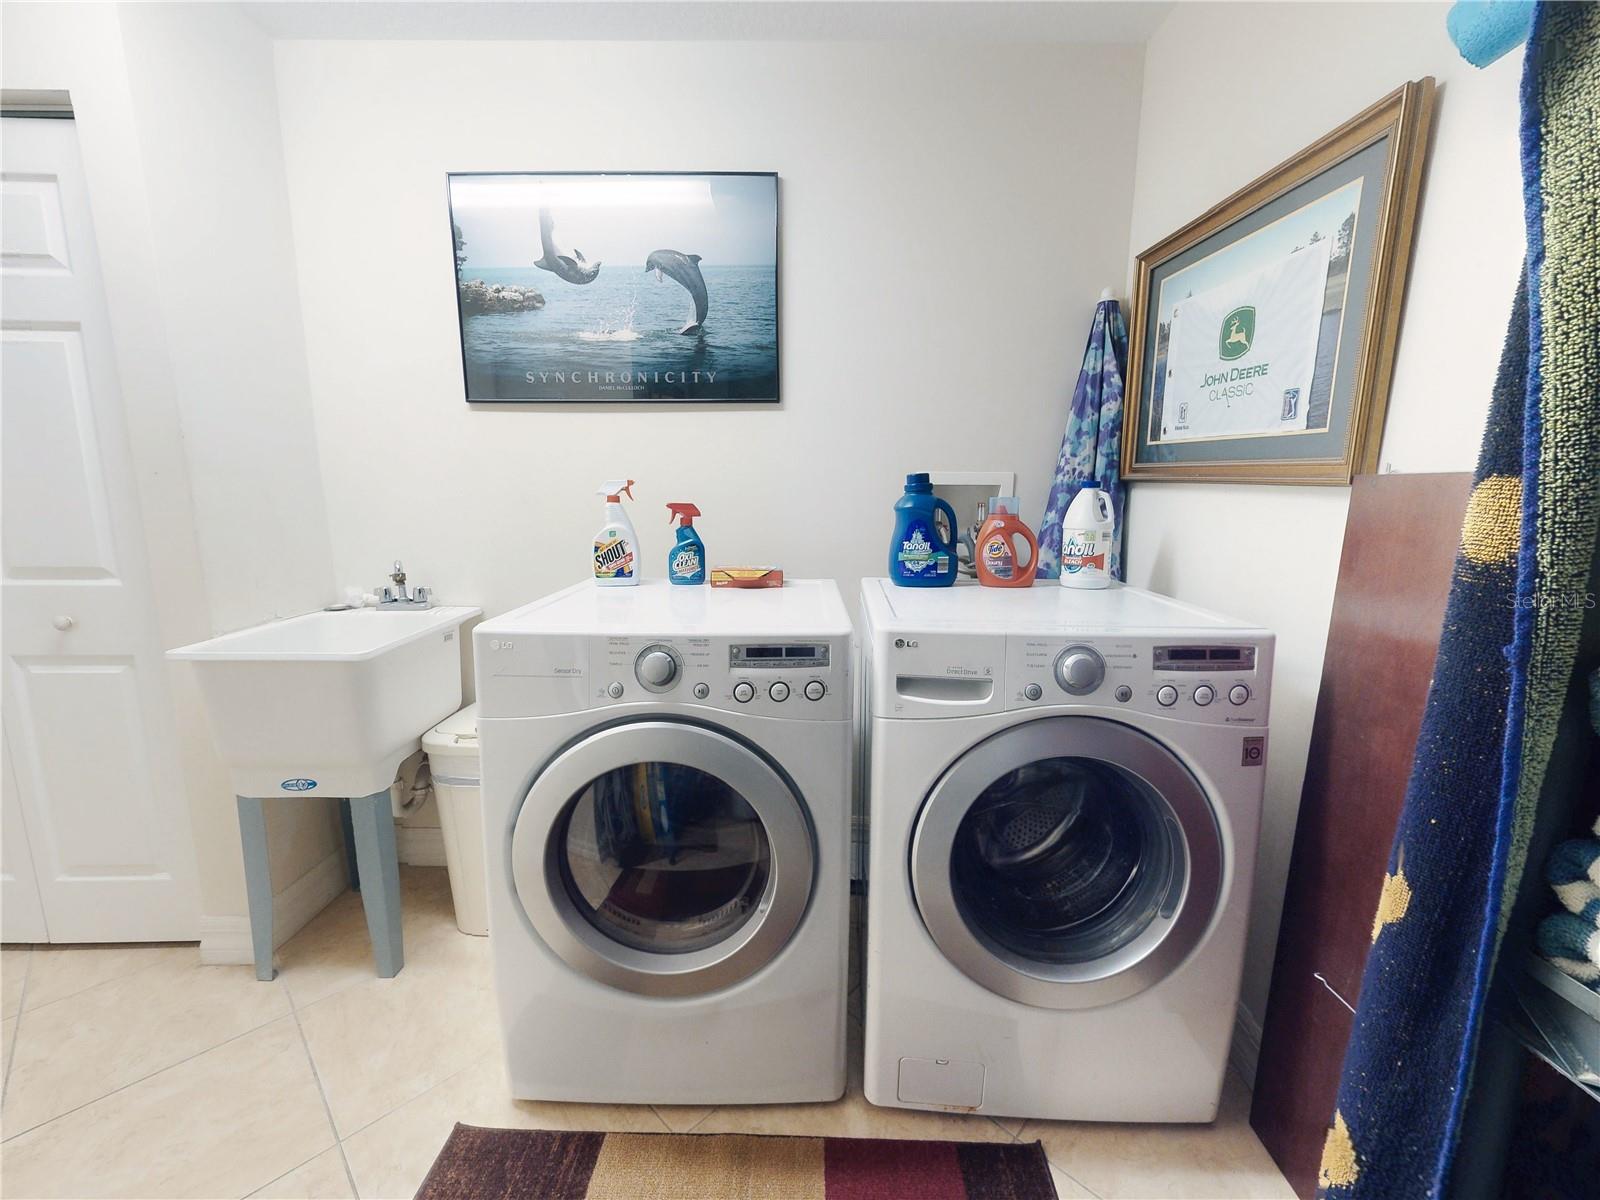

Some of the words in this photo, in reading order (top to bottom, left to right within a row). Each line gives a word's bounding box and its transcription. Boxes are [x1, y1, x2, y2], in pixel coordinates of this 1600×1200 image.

[525, 371, 717, 385] SYNCHRONICITY
[1200, 372, 1229, 388] JOHN
[1230, 363, 1269, 380] DEERE
[1209, 383, 1254, 401] CLASSIC
[595, 540, 626, 570] SHOUT
[988, 544, 1003, 554] Tide
[1063, 543, 1095, 556] andil
